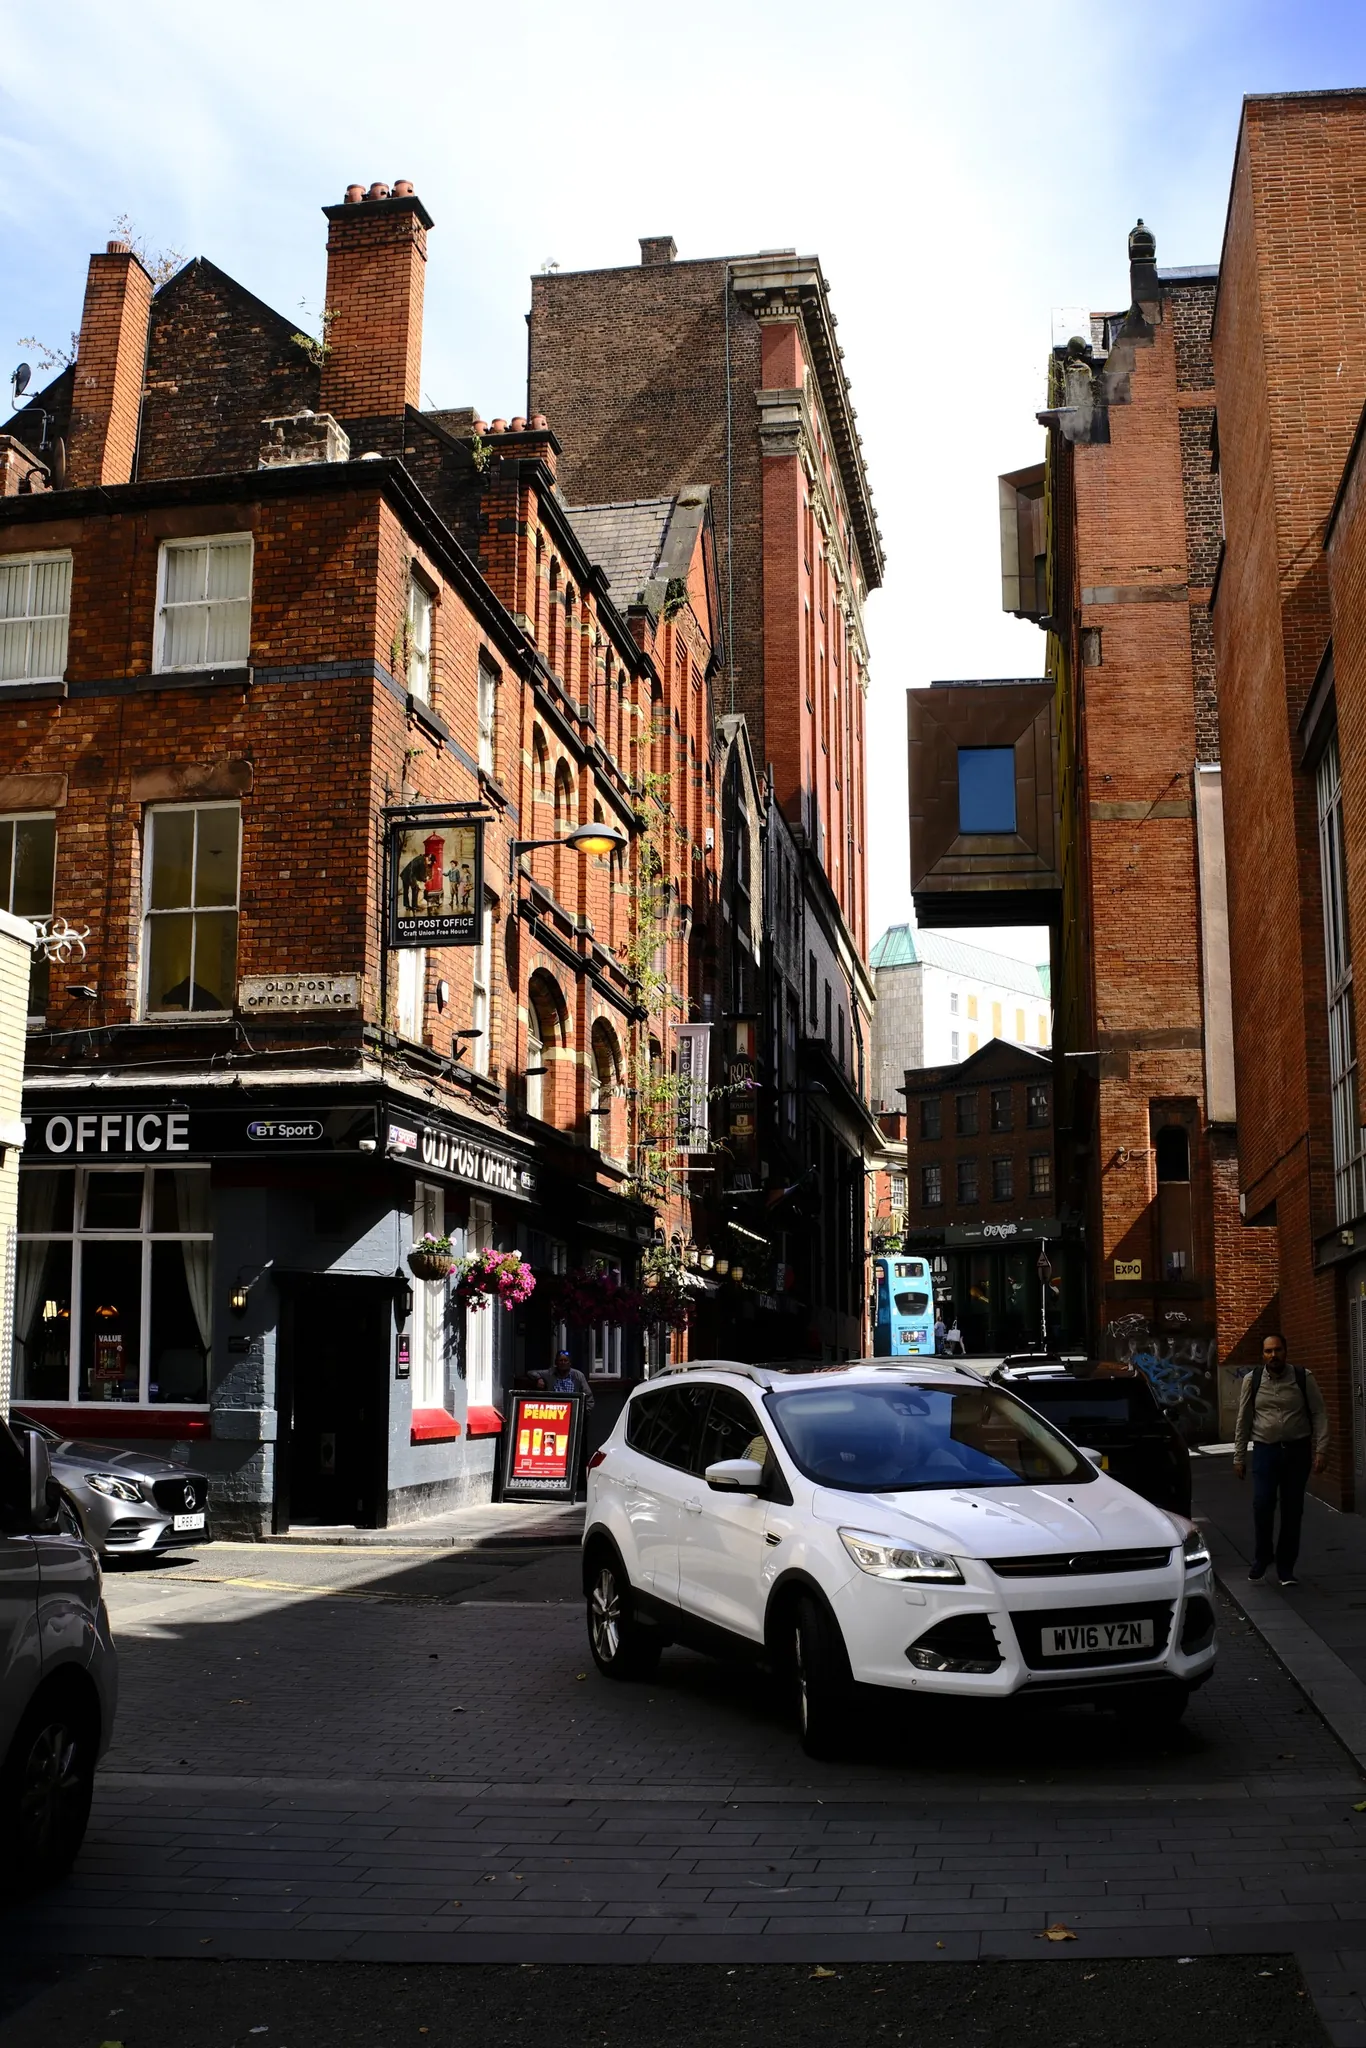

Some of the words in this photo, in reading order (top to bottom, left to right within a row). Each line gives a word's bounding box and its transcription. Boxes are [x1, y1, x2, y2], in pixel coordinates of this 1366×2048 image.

[398, 920, 416, 930] OLD
[418, 919, 441, 929] POST
[443, 918, 474, 928] OFFICE
[266, 982, 294, 992] OLD
[298, 981, 335, 991] POST
[248, 995, 301, 1006] OFFICE
[303, 993, 352, 1004] PLACE
[45, 1113, 190, 1153] OFFICE
[256, 1125, 276, 1137] BT
[278, 1124, 314, 1139] Sport
[422, 1127, 448, 1168] OLD
[450, 1137, 481, 1179] POST
[482, 1149, 517, 1192] OFFICE
[1115, 1264, 1141, 1274] EXPO
[98, 1334, 122, 1342] VALUE
[524, 1409, 567, 1420] PENNY
[1054, 1627, 1098, 1650] WV16
[1104, 1624, 1141, 1646] YZN
